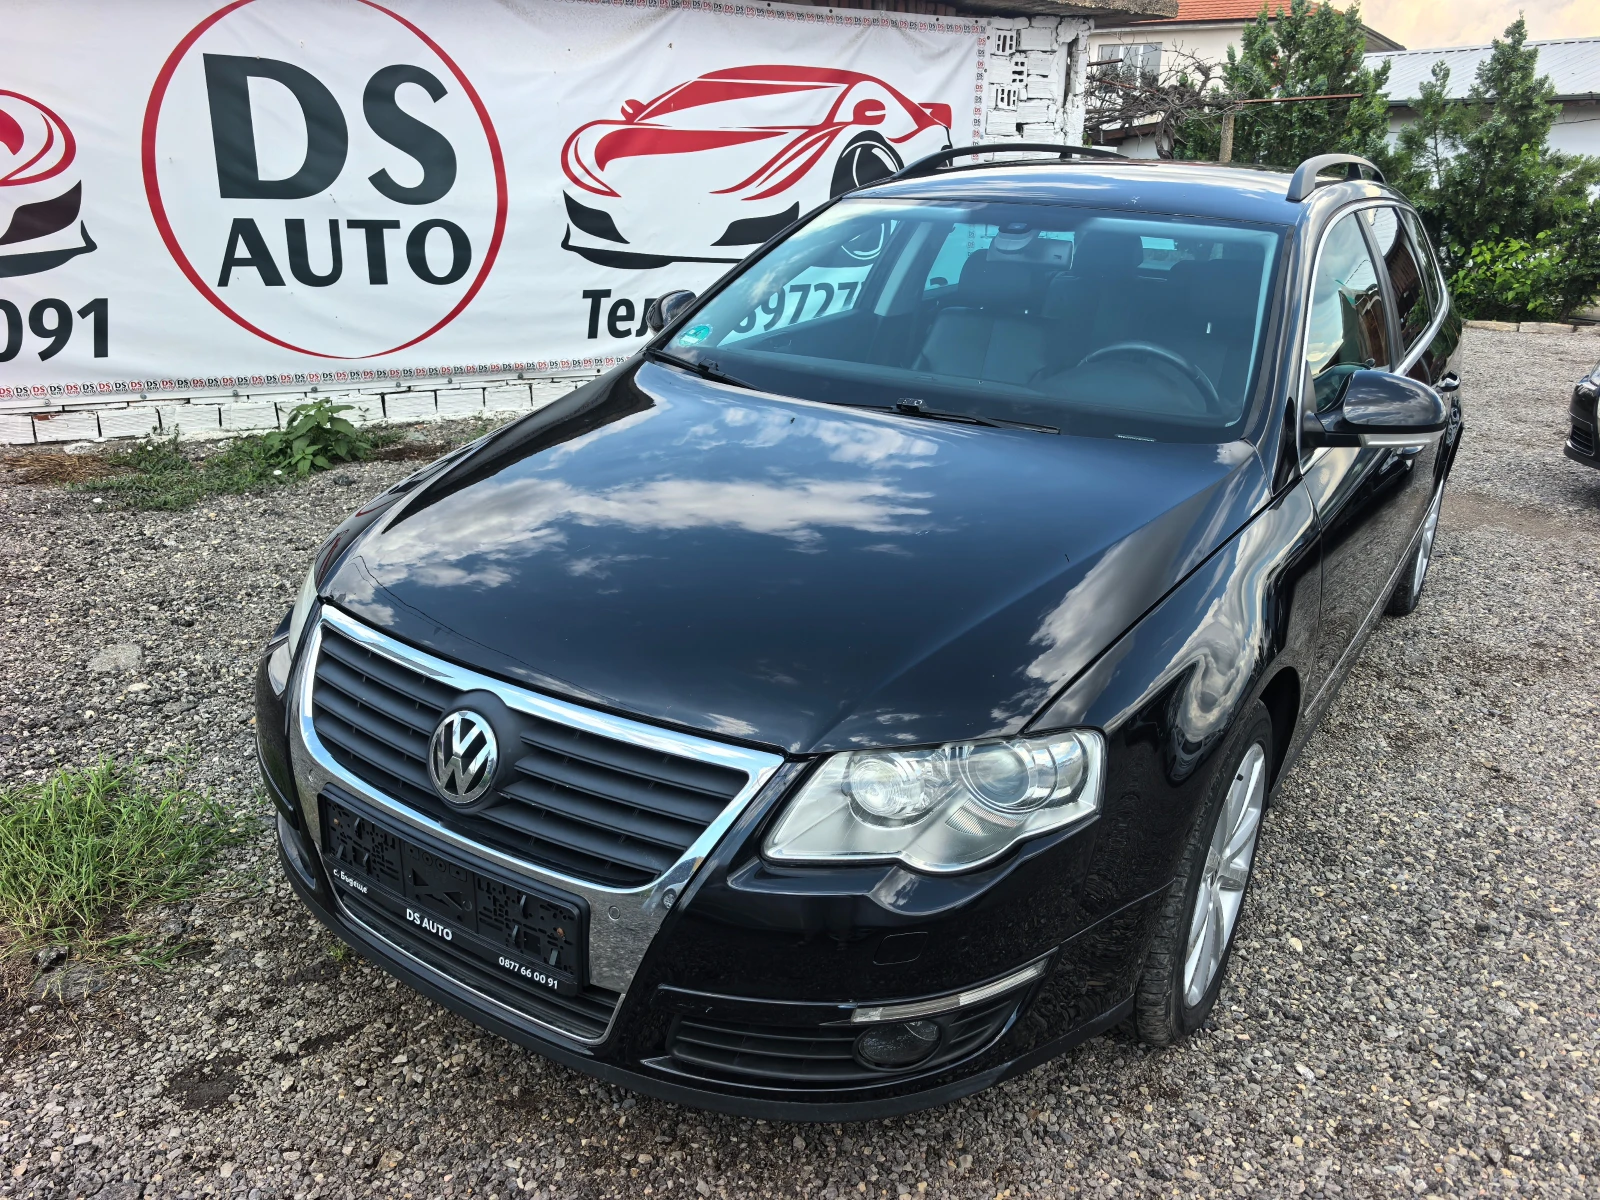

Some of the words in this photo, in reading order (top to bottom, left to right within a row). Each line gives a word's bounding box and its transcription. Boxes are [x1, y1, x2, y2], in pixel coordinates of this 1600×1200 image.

[203, 53, 457, 205] DS
[217, 217, 472, 287] AUTO
[430, 711, 497, 803] VW
[406, 908, 421, 925] DS
[421, 917, 452, 941] AUTO
[498, 956, 520, 972] 0877
[520, 966, 532, 978] 66
[534, 971, 546, 984] 00
[548, 978, 558, 990] 91
